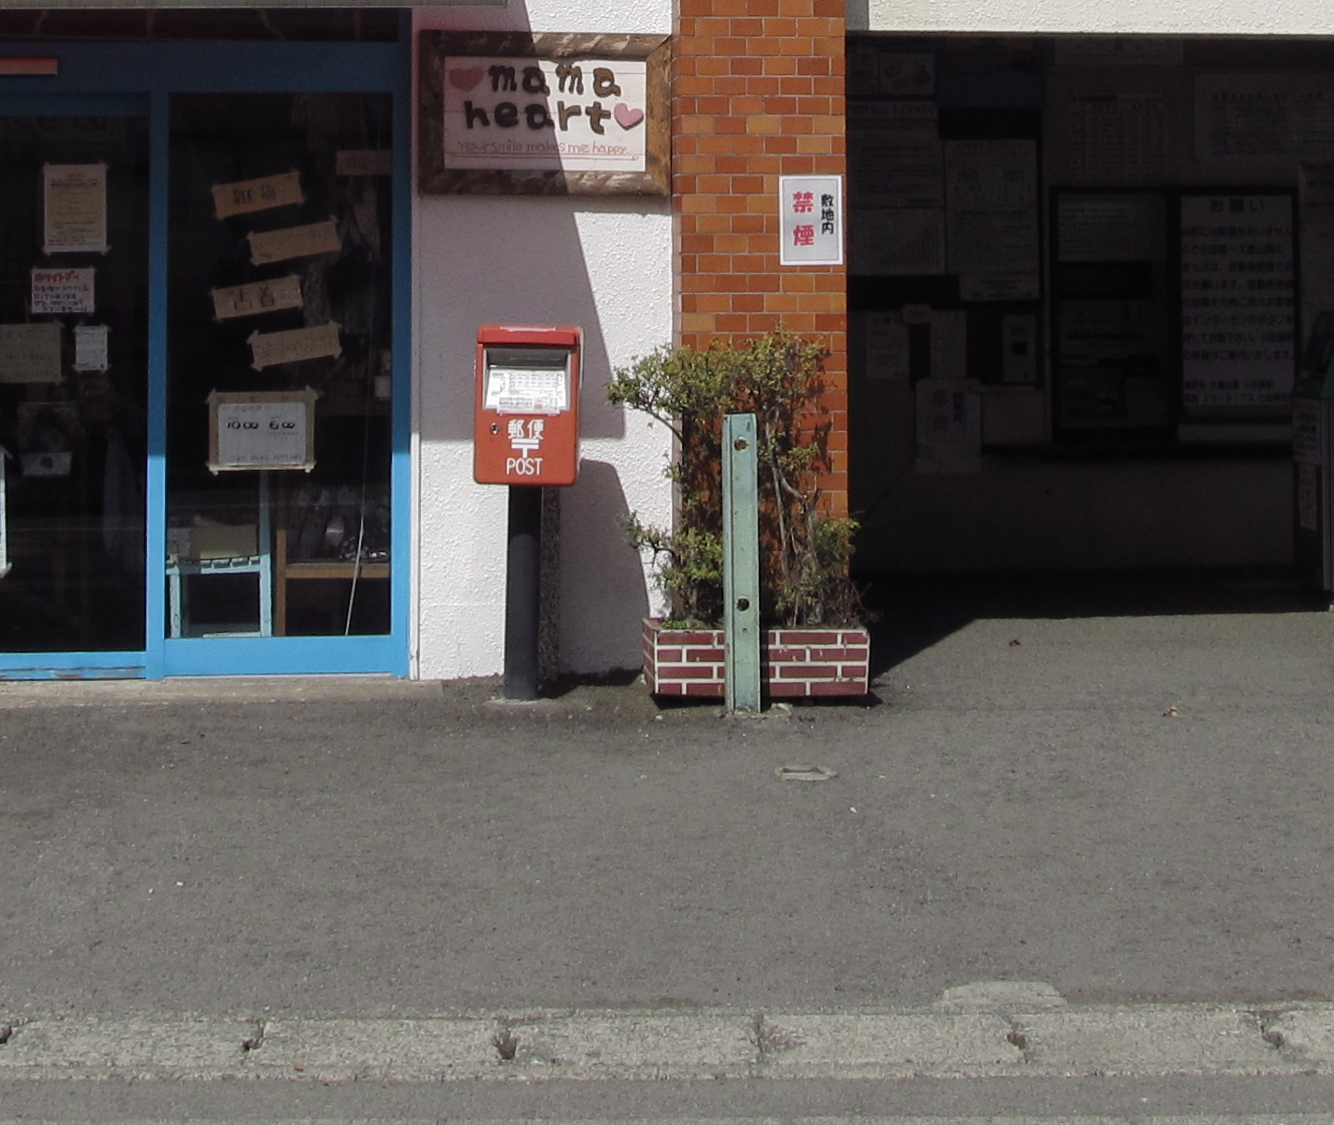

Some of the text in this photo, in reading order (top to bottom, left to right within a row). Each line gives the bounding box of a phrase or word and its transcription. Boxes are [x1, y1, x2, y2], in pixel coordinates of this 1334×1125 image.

[488, 64, 622, 98] mama
[464, 101, 612, 135] heart
[568, 142, 589, 153] me
[593, 140, 629, 155] happy.
[792, 191, 814, 246] 禁煙
[820, 193, 834, 234] 敷地内
[508, 419, 545, 440] 郵便
[506, 458, 544, 476] POST
